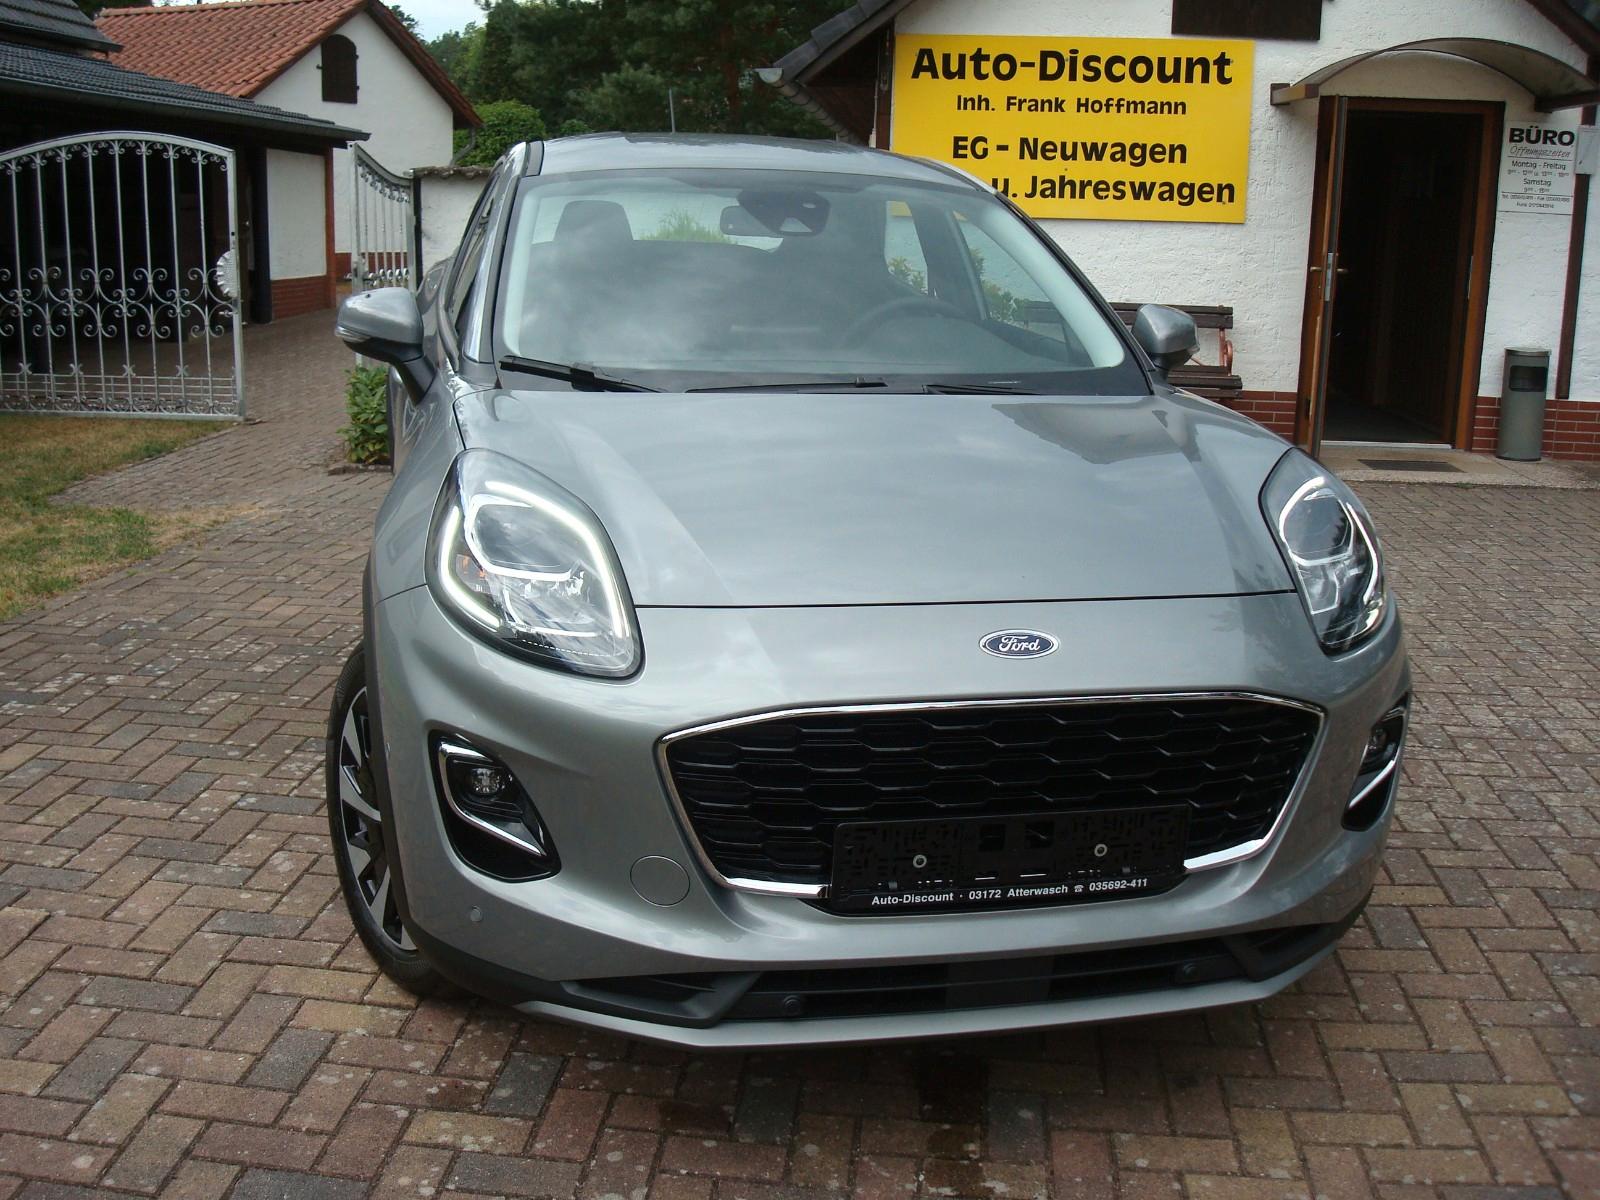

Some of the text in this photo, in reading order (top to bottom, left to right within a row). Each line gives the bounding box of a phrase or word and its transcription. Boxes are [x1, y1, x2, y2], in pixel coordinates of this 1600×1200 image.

[911, 47, 1233, 85] Auto-Discount
[956, 95, 1187, 115] Inh. Frank Hoffmann
[1509, 125, 1575, 146] BÜRO
[952, 135, 989, 160] EG
[1018, 137, 1187, 166] Neuwagen
[1512, 160, 1537, 168] Montag
[1543, 162, 1566, 170] Freitag
[1024, 175, 1236, 206] Jahreswagen
[1523, 178, 1552, 186] Samstag
[998, 635, 1041, 652] Ford
[871, 878, 1148, 905] Auto-Discount 03172 Atterwasch 035692-411
